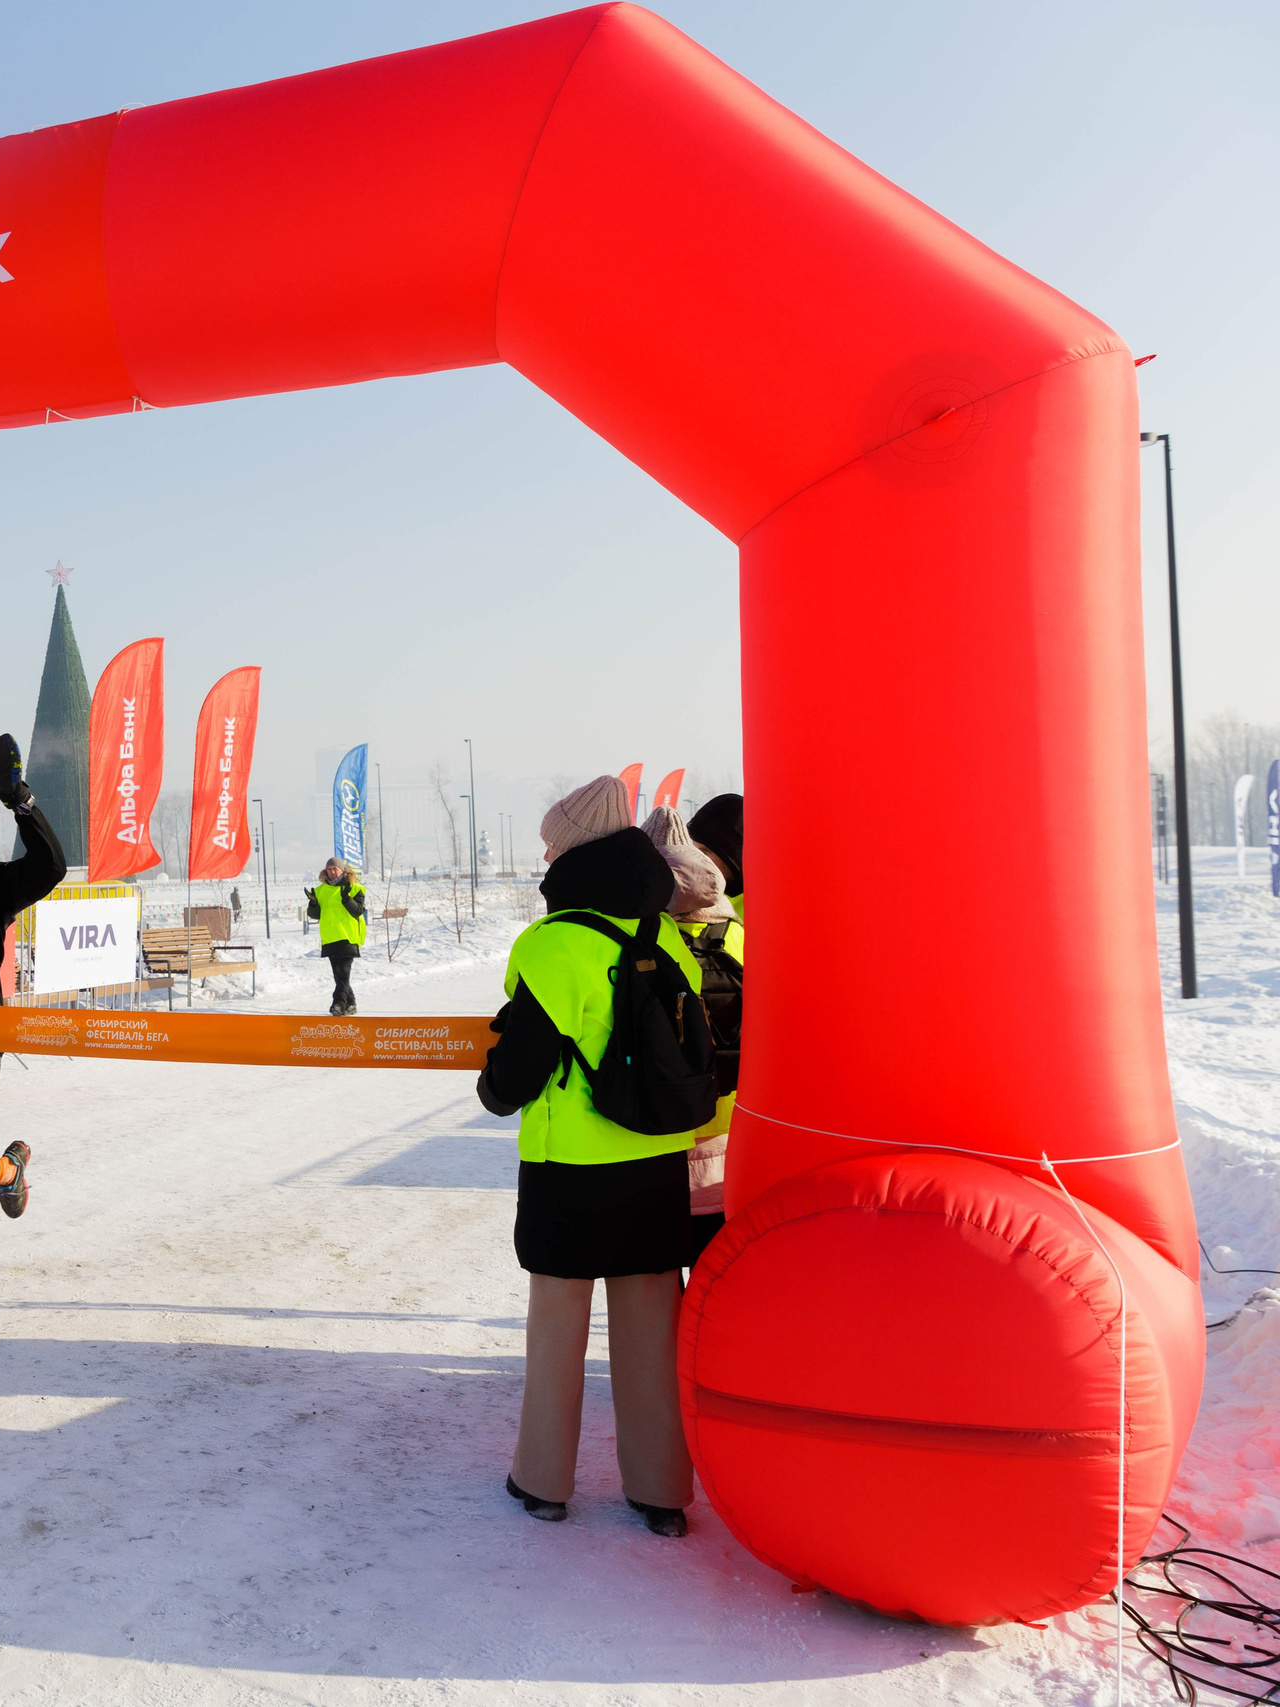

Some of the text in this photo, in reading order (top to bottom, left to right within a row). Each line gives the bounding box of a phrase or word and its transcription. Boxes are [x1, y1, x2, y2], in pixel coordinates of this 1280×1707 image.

[117, 696, 140, 844] Альфа Банк
[212, 717, 236, 850] Альфа Банк
[59, 924, 117, 950] VIRA
[85, 1019, 148, 1030] СИБИРСКИЙ
[86, 1030, 169, 1042] ФЕСТИВАЛЬ БЕГА
[375, 1026, 450, 1038] СИБИРСКИЙ
[84, 1042, 153, 1051] www.marafon.nsk.ru
[374, 1039, 474, 1051] ФЕСТИВАЛЬ БЕГА
